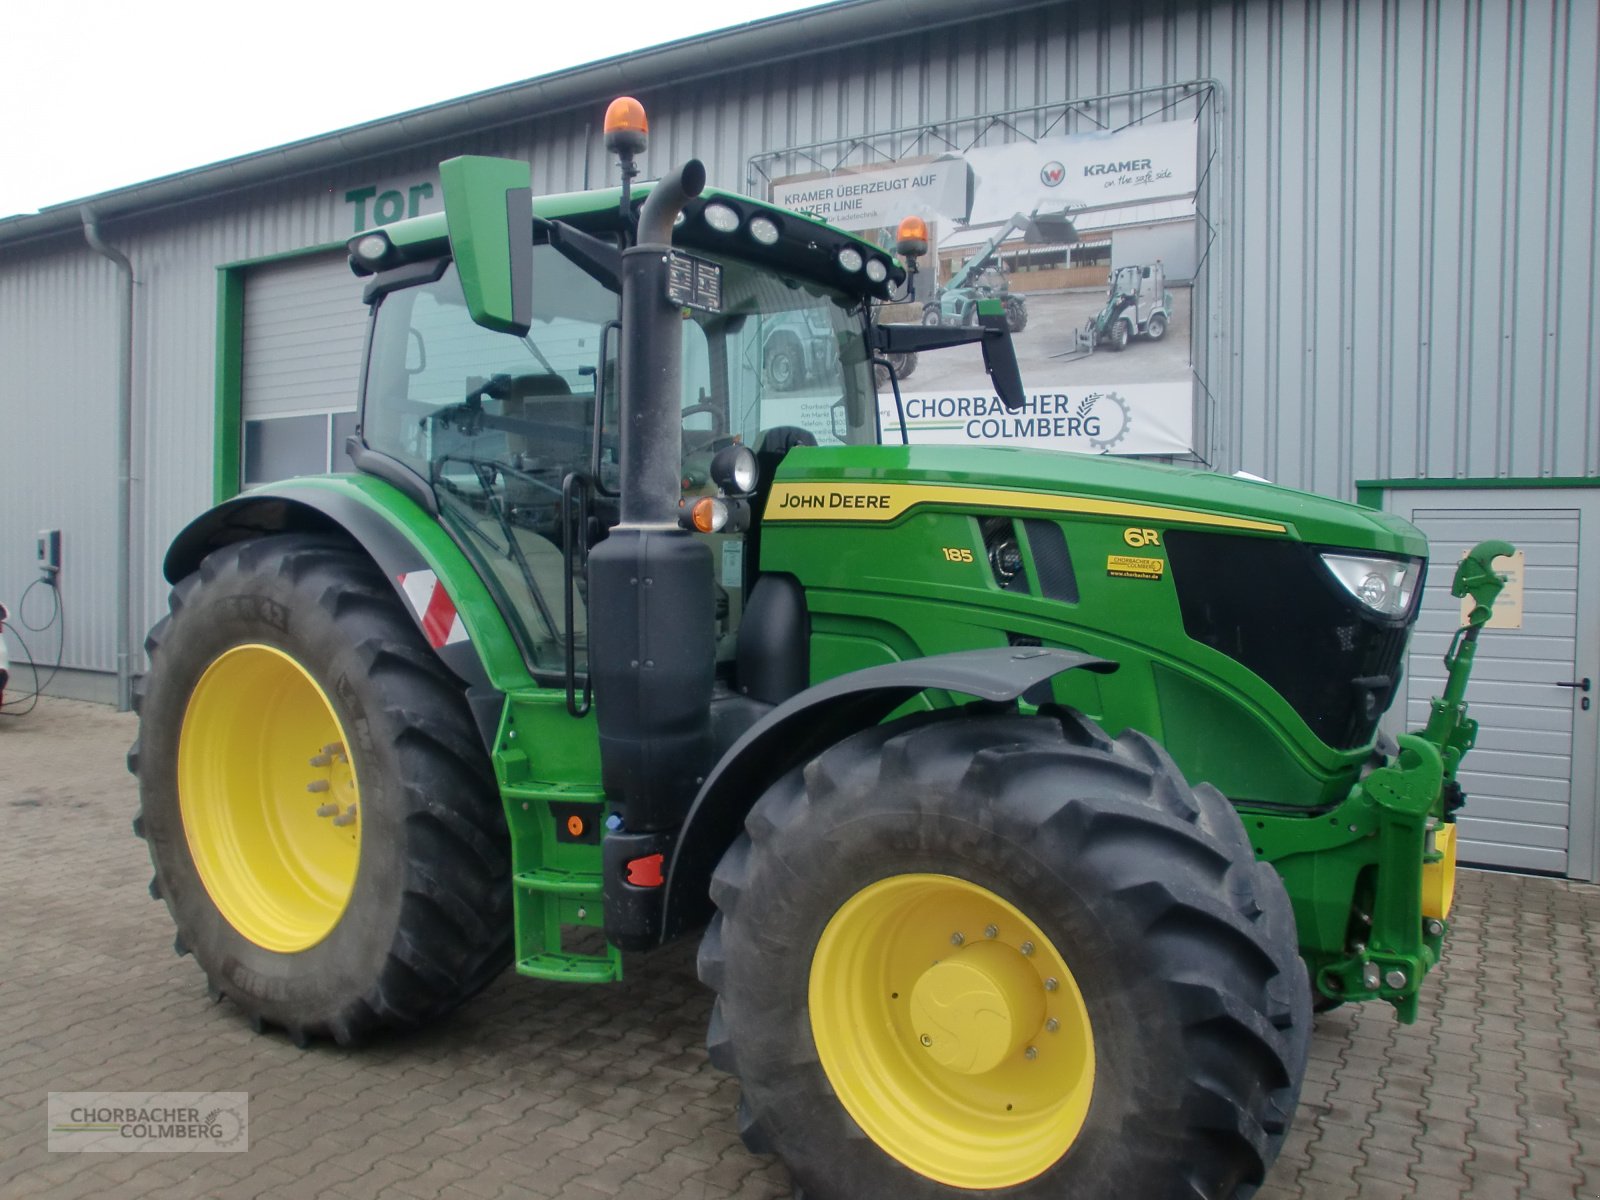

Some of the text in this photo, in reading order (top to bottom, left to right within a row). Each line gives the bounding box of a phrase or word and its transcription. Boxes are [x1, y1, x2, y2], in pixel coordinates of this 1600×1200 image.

[1084, 159, 1152, 176] KRAMER
[1104, 168, 1172, 189] on the safe side
[785, 174, 936, 205] KRAMER ÜBERZEUGT AUF
[345, 182, 433, 233] Tor
[787, 199, 862, 214] ANZER LINIE
[966, 416, 1101, 438] COLMBERG
[780, 493, 890, 508] JOHN DEERE
[1124, 527, 1160, 547] 6R
[942, 547, 974, 562] 185
